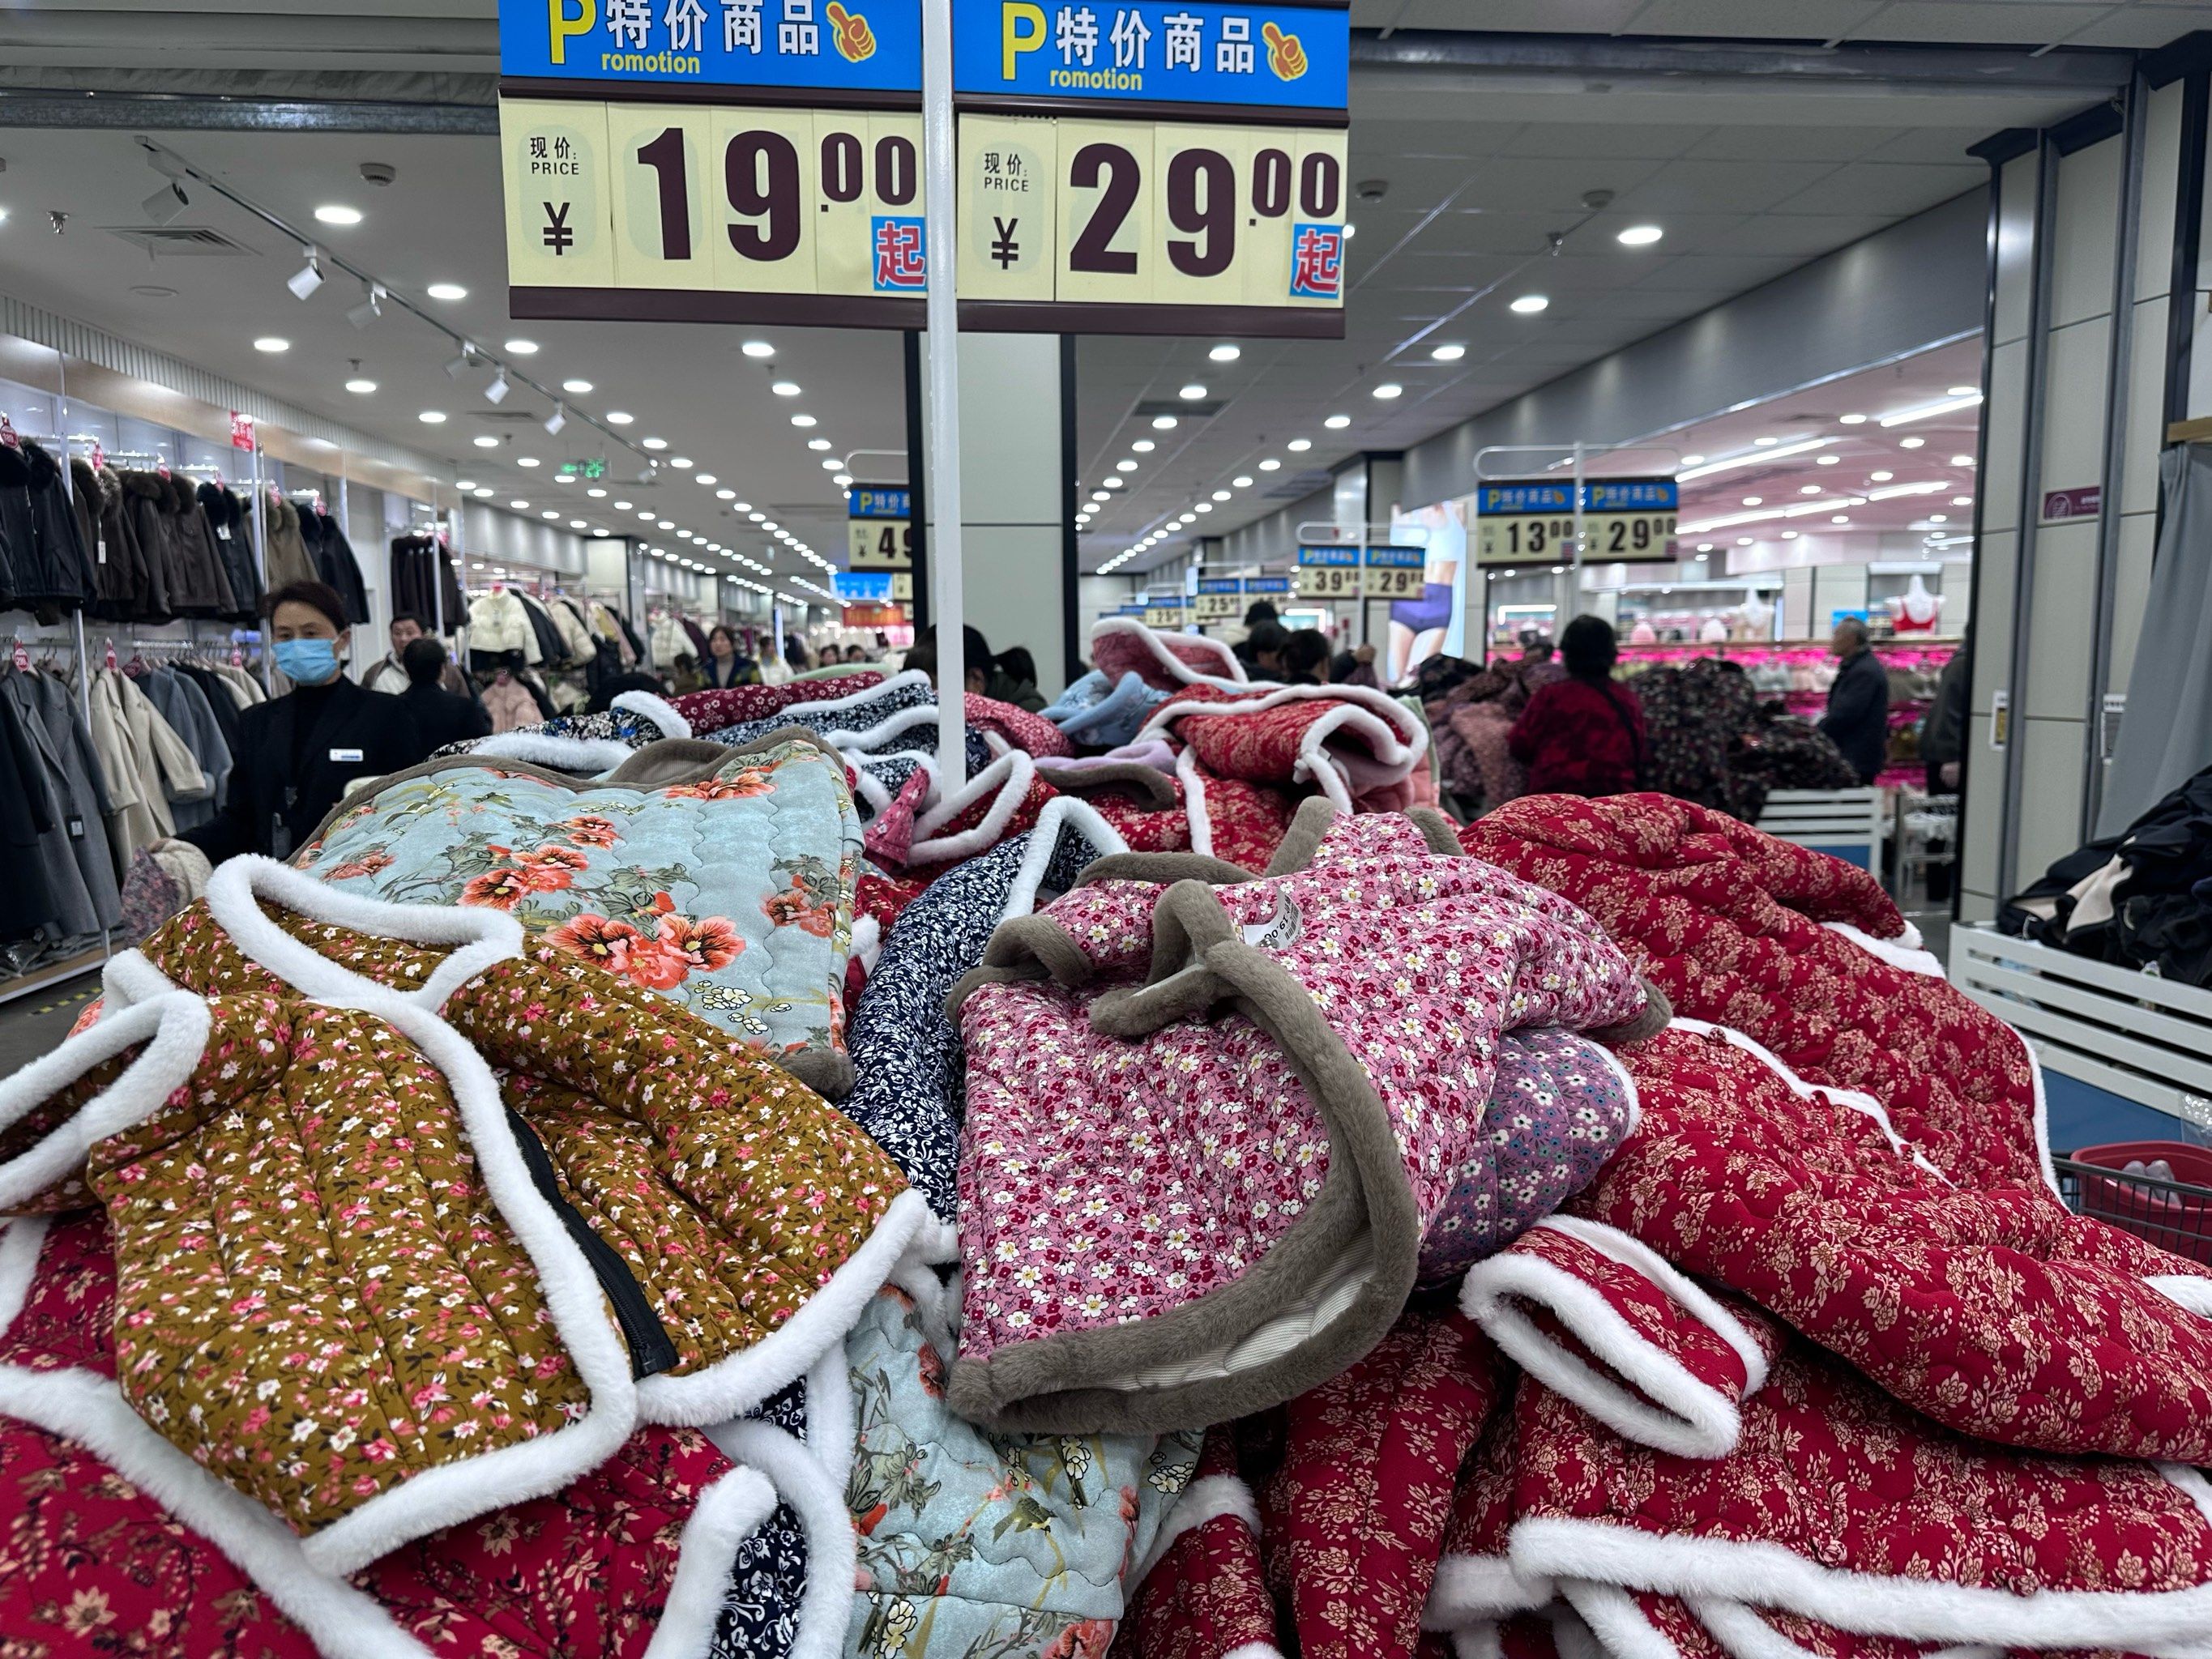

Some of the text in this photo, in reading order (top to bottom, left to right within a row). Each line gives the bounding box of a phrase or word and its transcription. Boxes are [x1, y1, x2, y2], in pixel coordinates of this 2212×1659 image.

[606, 0, 820, 55] 特价商品
[1056, 6, 1255, 75] 特价商品
[532, 162, 579, 175] PRICE
[984, 177, 1029, 192] PRICE
[878, 221, 926, 286] 起
[1294, 228, 1339, 295] 起
